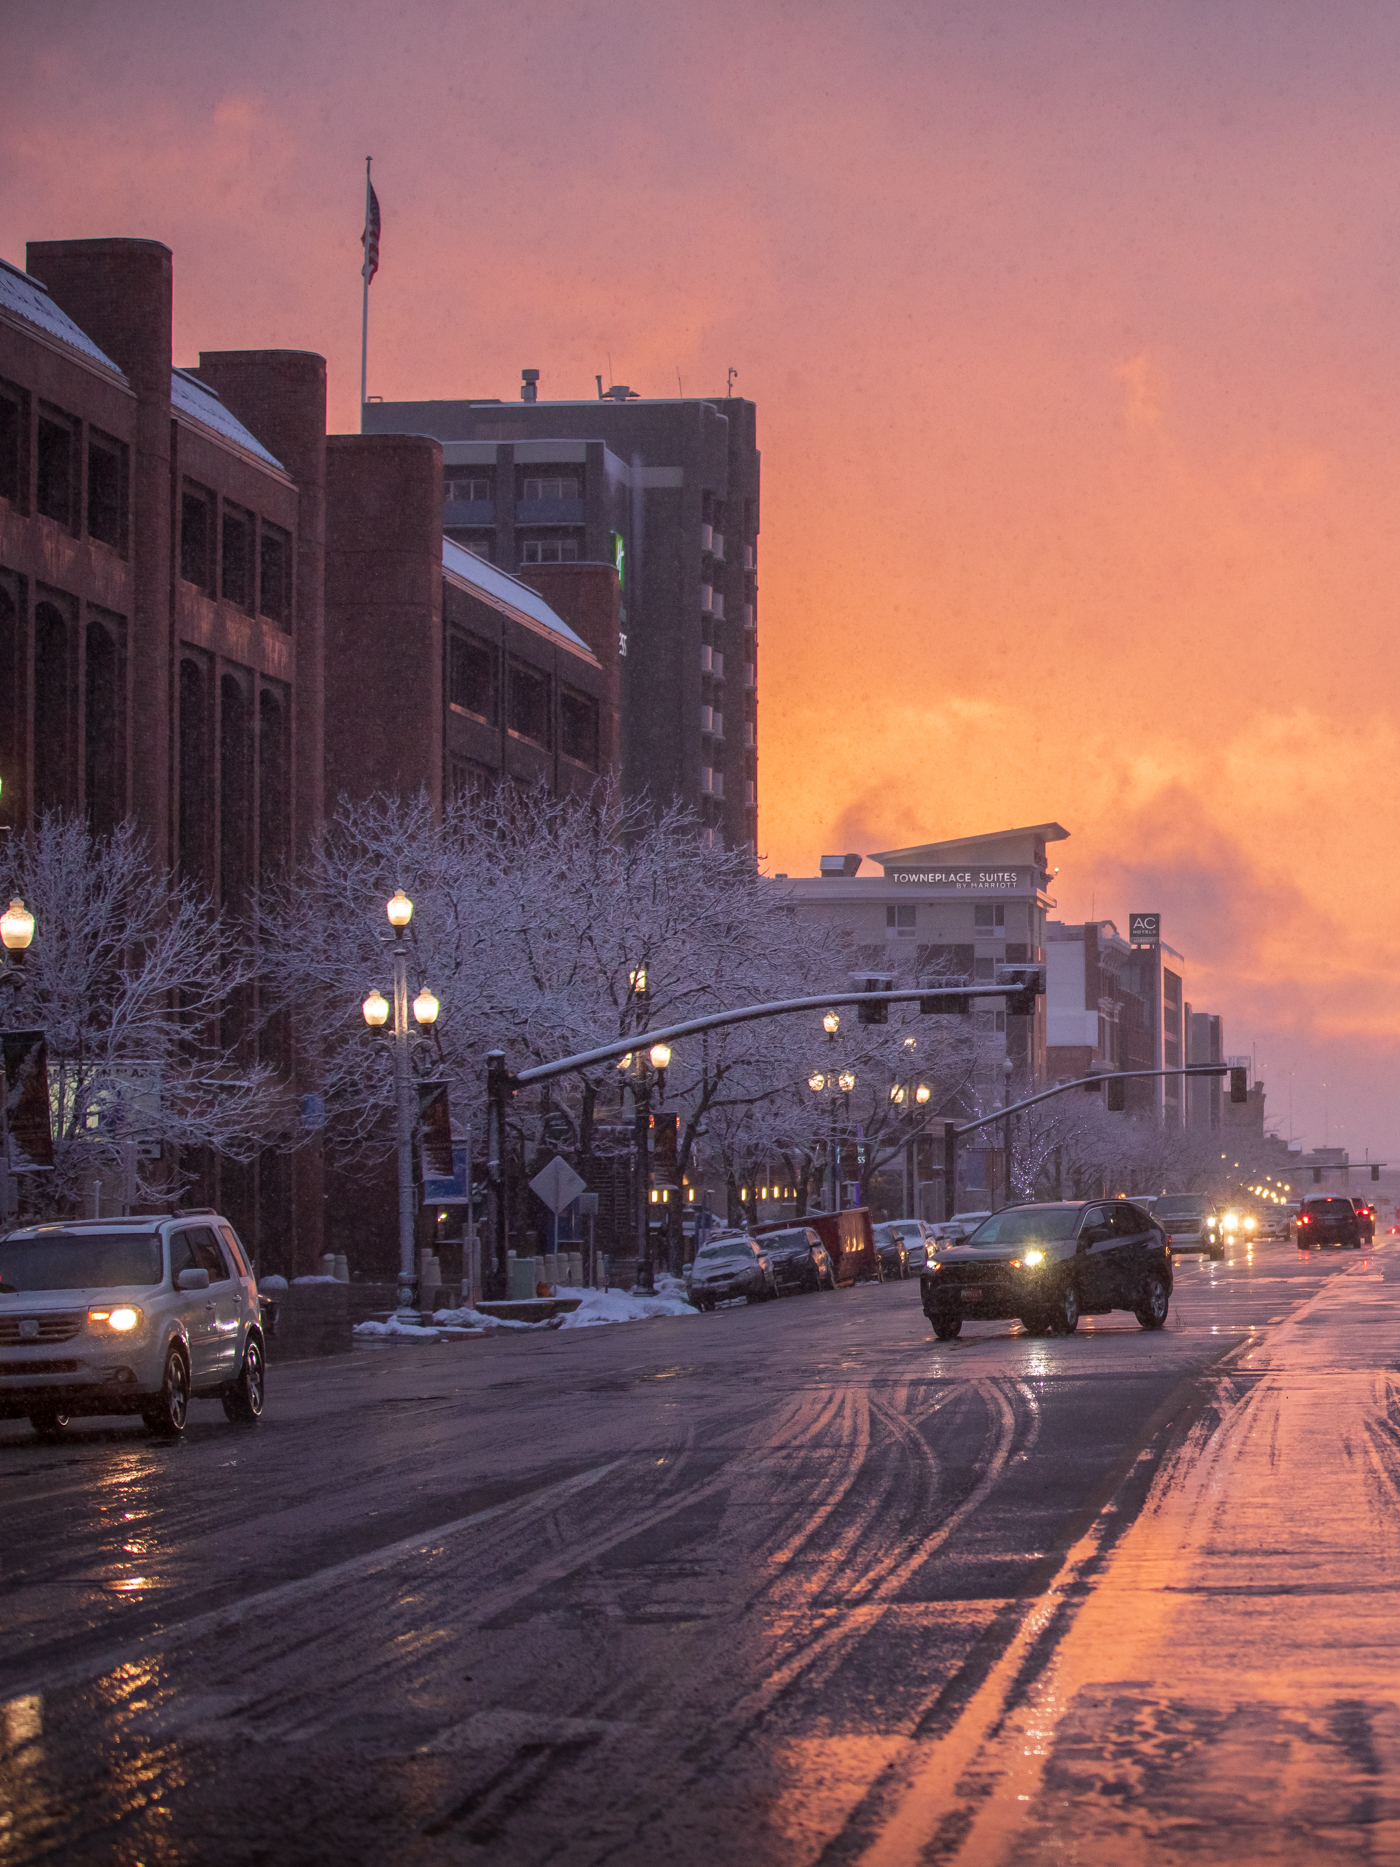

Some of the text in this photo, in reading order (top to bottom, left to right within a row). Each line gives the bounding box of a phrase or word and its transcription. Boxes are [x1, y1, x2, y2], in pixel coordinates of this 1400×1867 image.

[893, 873, 1017, 883] TOWNEPLACE SUITES
[1133, 917, 1156, 929] AC
